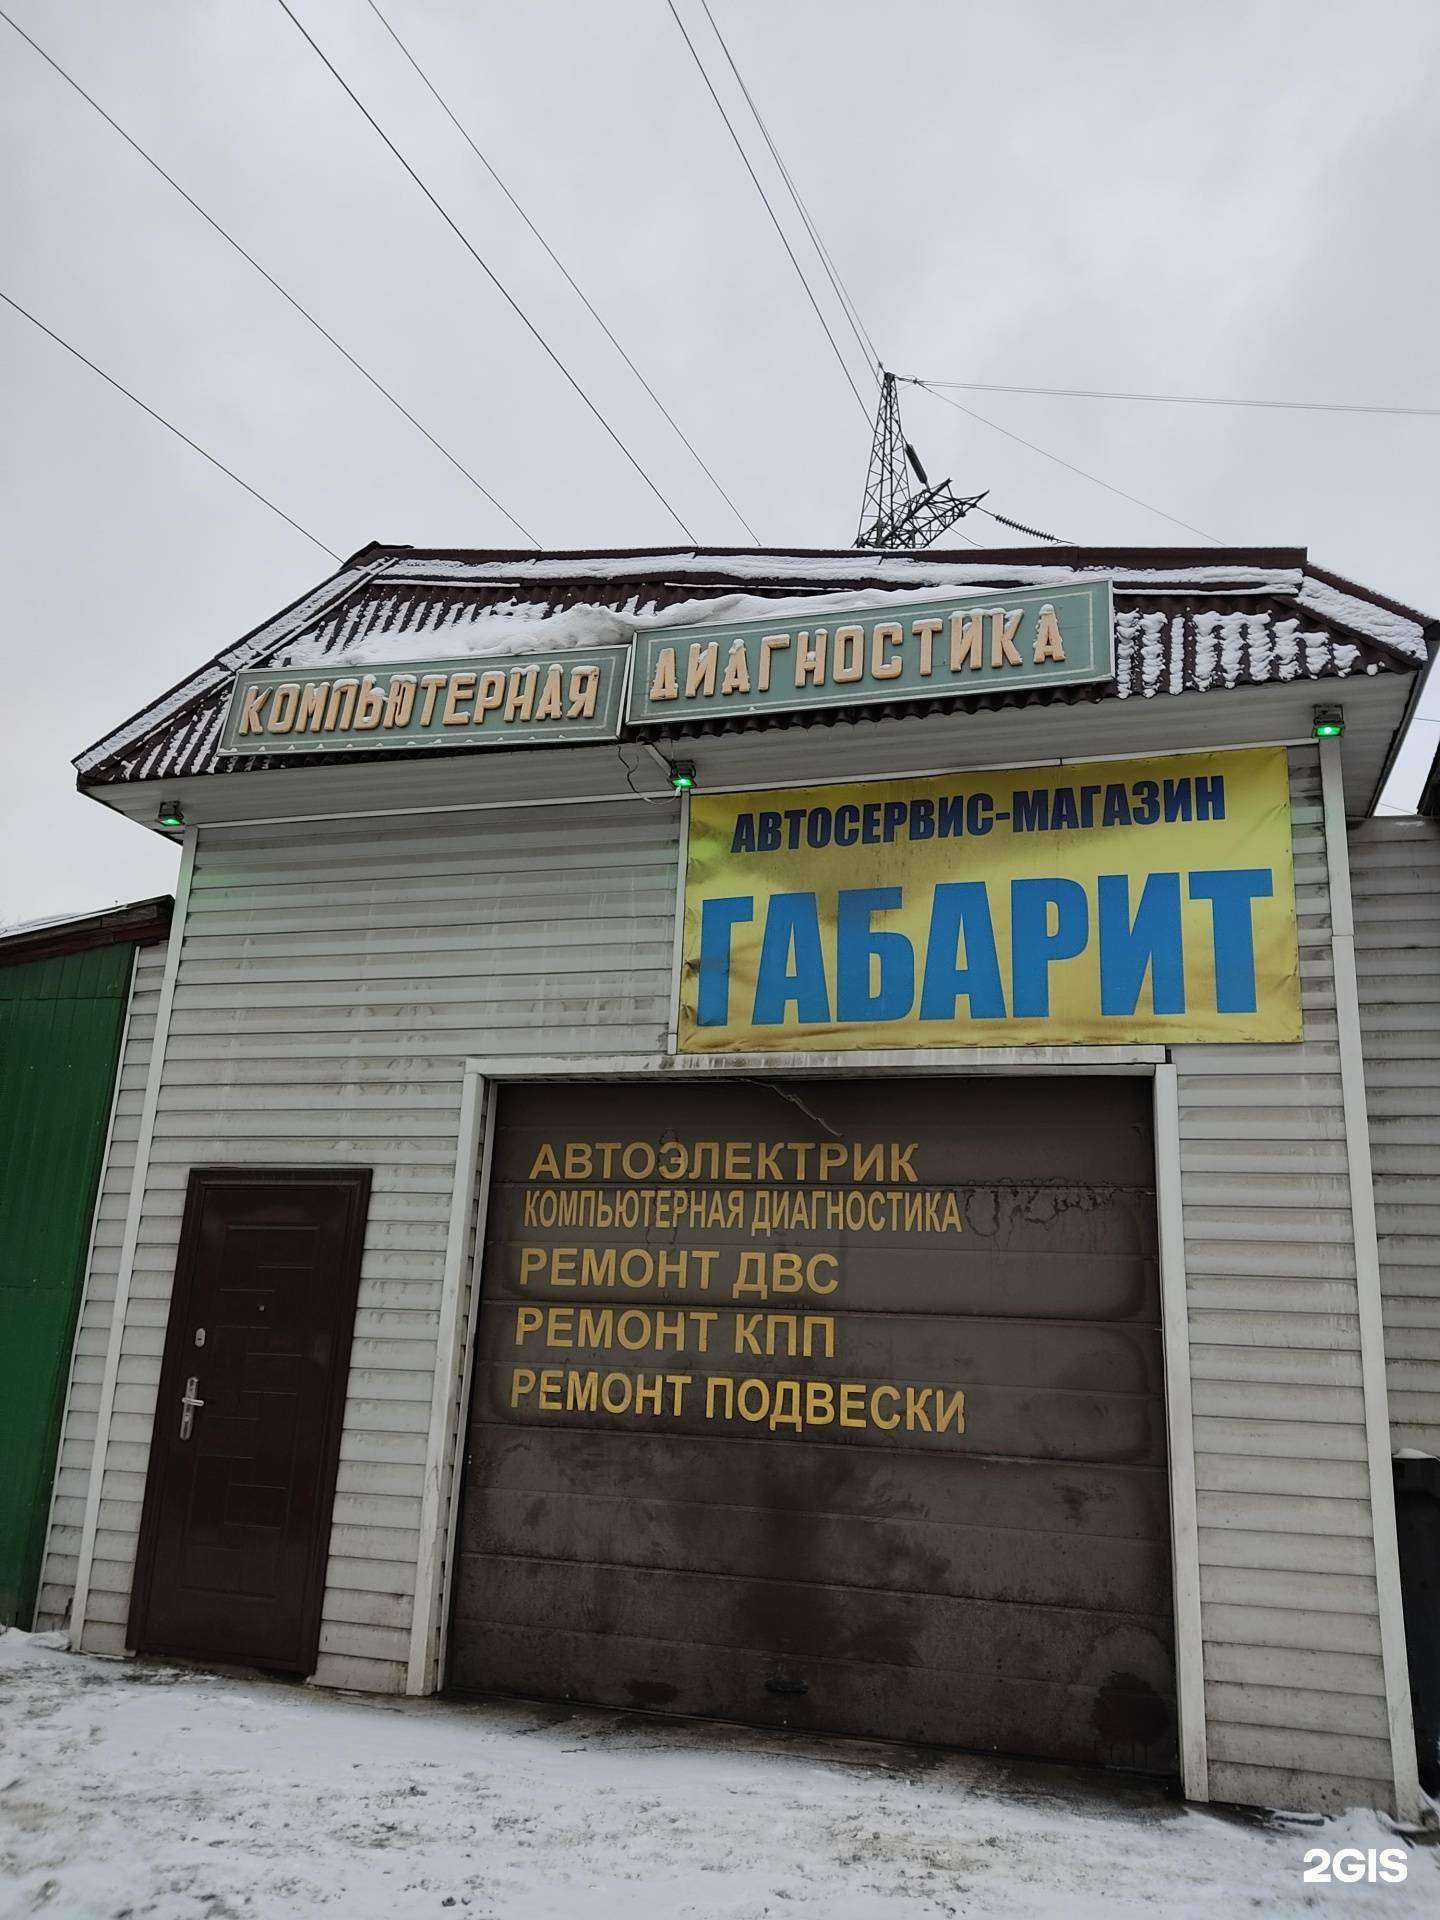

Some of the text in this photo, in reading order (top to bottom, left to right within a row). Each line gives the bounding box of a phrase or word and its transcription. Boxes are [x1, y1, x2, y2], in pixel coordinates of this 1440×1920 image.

[239, 603, 1066, 735] КОМПЬЮТЕРНАЯ ДИАГНОСТИКА
[731, 775, 1226, 853] АВТОСЕРВИС-МАГАЗИН
[697, 868, 1273, 1027] ГАБАРИТ
[529, 1141, 919, 1182] АВТОЭЛЕКТРИК
[523, 1189, 963, 1237] КОМПЬЮТЕРНАЯ ДИАГНОСТИКА
[519, 1248, 839, 1300] РЕМОНТ ДВС
[514, 1306, 835, 1358] РЕМОНТ КПП
[510, 1368, 966, 1434] РЕМОНТ ПОДВЕСКИ
